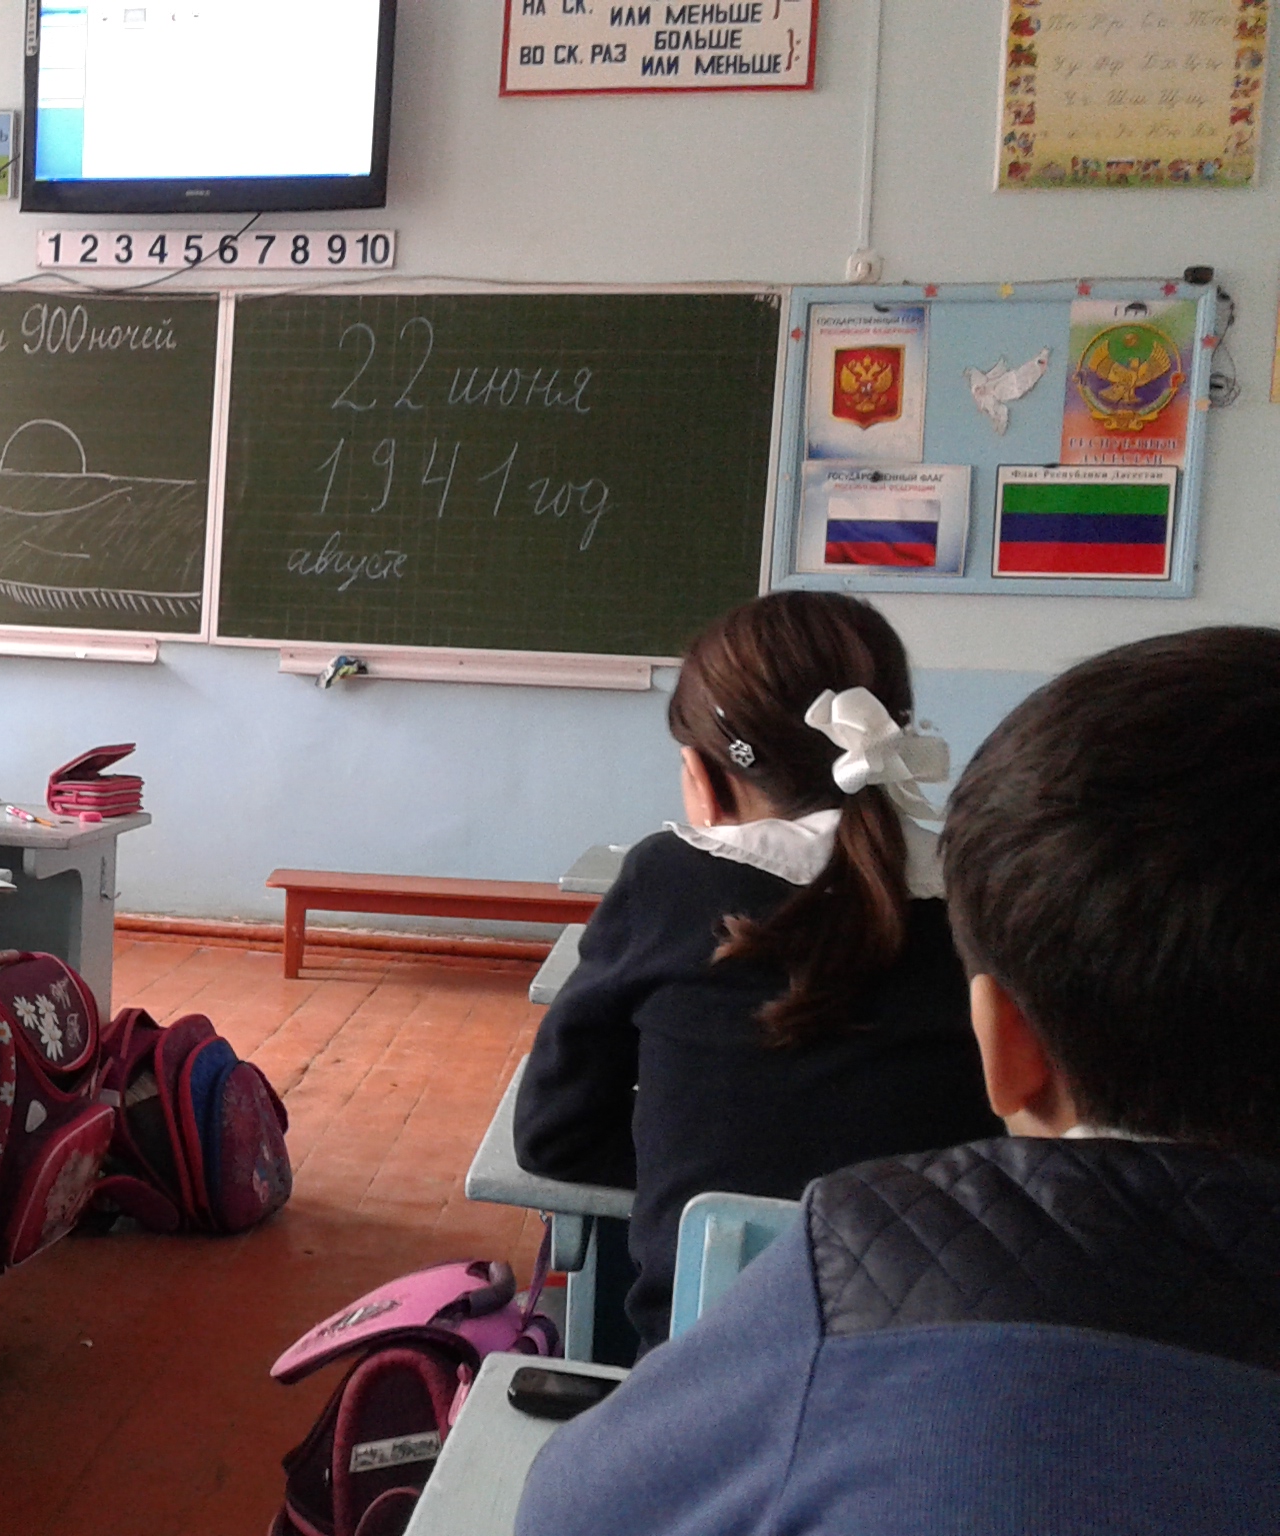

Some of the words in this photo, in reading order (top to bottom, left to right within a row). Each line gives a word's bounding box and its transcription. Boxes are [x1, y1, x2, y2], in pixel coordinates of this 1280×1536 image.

[610, 6, 651, 26] ИЛИ
[665, 3, 762, 25] МЕНЬШЕ
[654, 29, 742, 50] БОЛЬШЕ
[520, 46, 544, 65] ВО
[590, 43, 627, 64] РАЗ
[641, 55, 679, 76] ИЛИ
[694, 53, 782, 75] МЕНЬШЕ
[48, 234, 62, 264] 1
[80, 234, 99, 264] 2
[115, 234, 133, 264] 3
[148, 234, 168, 264] 4
[184, 234, 203, 264] 5
[220, 234, 239, 264] 6
[255, 234, 276, 264] 7
[291, 234, 309, 264] 8
[328, 234, 347, 264] 9
[356, 234, 390, 264] 10
[20, 302, 88, 354] 900
[88, 319, 177, 350] ночей
[331, 316, 433, 411] 22
[448, 366, 592, 413] июня
[317, 437, 518, 518] 1941
[528, 478, 610, 551] год
